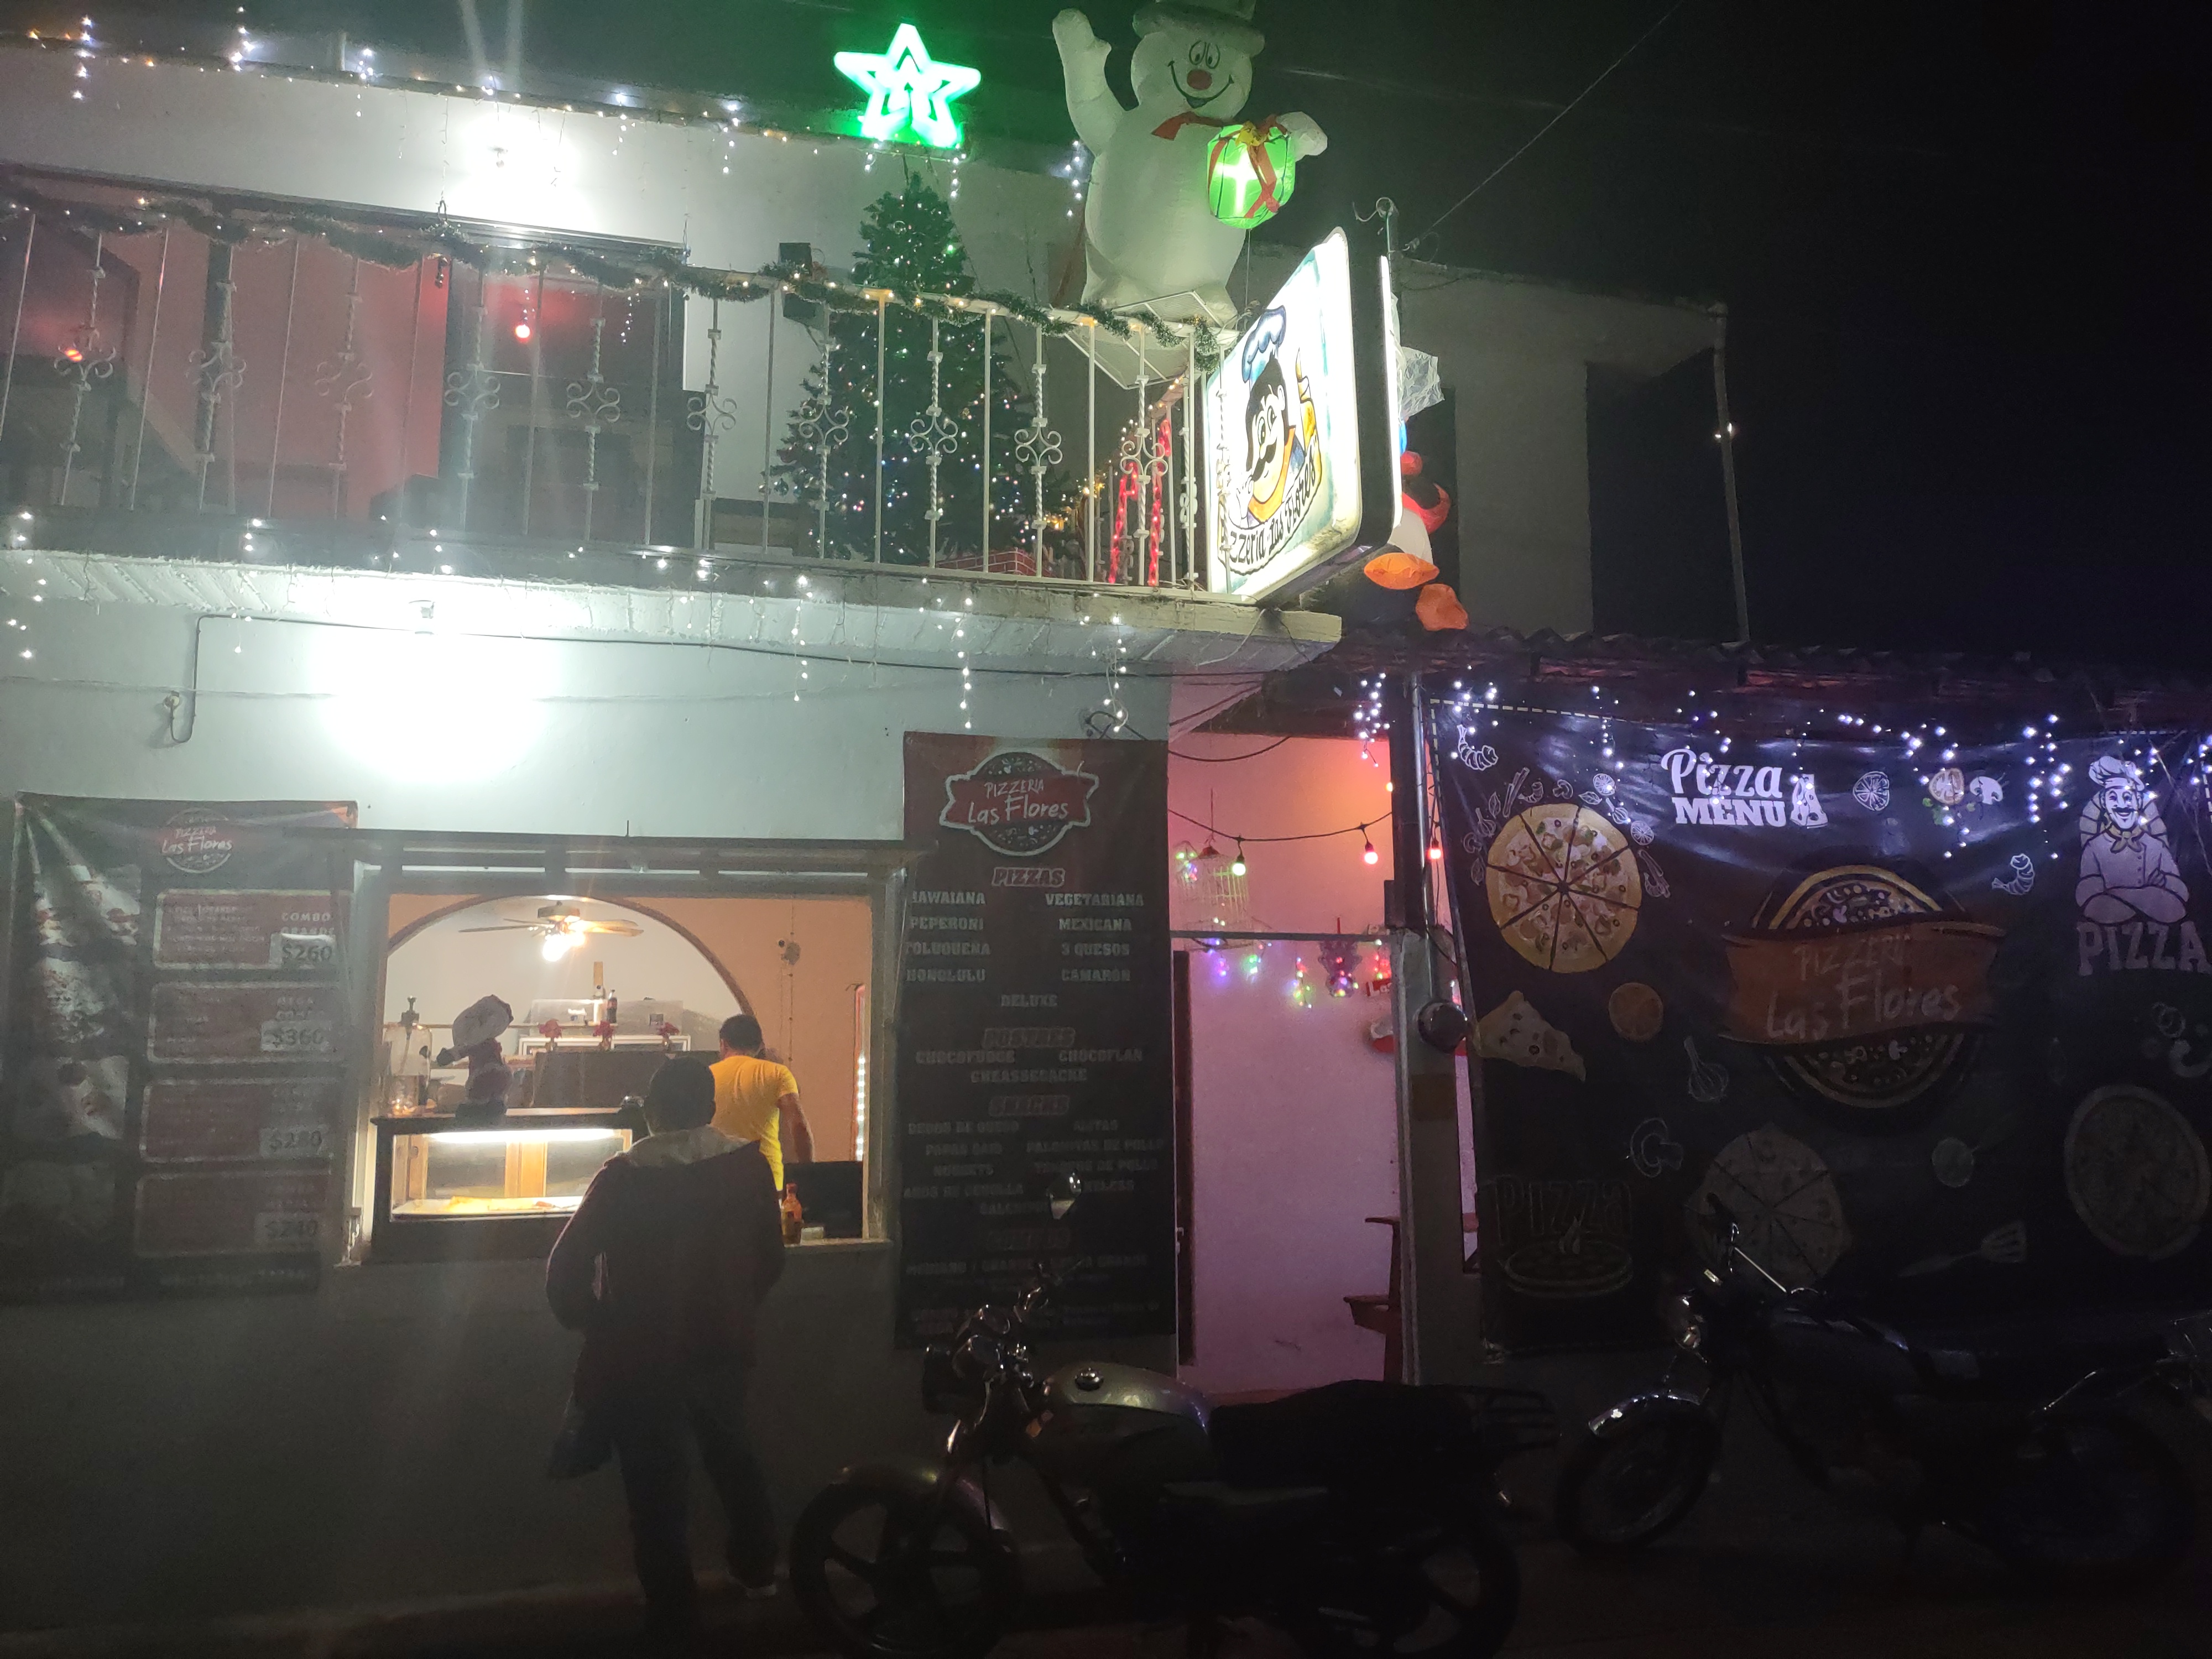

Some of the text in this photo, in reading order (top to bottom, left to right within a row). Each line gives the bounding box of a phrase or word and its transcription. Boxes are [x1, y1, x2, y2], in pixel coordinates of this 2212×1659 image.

[1220, 521, 1266, 565] zzeria
[1661, 749, 1782, 798] Pizza
[984, 778, 1044, 799] PIZZERIA
[968, 794, 1068, 825] Las Flores
[1672, 797, 1786, 827] MENU
[161, 839, 184, 854] Las
[993, 868, 1065, 886] PIZZAS
[1045, 893, 1144, 906] VEGETARIANA
[910, 917, 983, 930] PEPERONI
[1059, 918, 1131, 931] MEXICANA
[283, 943, 333, 962] $260
[1074, 942, 1130, 957] QUESOS
[2077, 921, 2212, 975] PIZZA
[1792, 935, 1911, 982] PIZZERI
[906, 969, 986, 982] HONOLULU
[1001, 994, 1057, 1008] DELUXE
[1767, 990, 1829, 1040] Las
